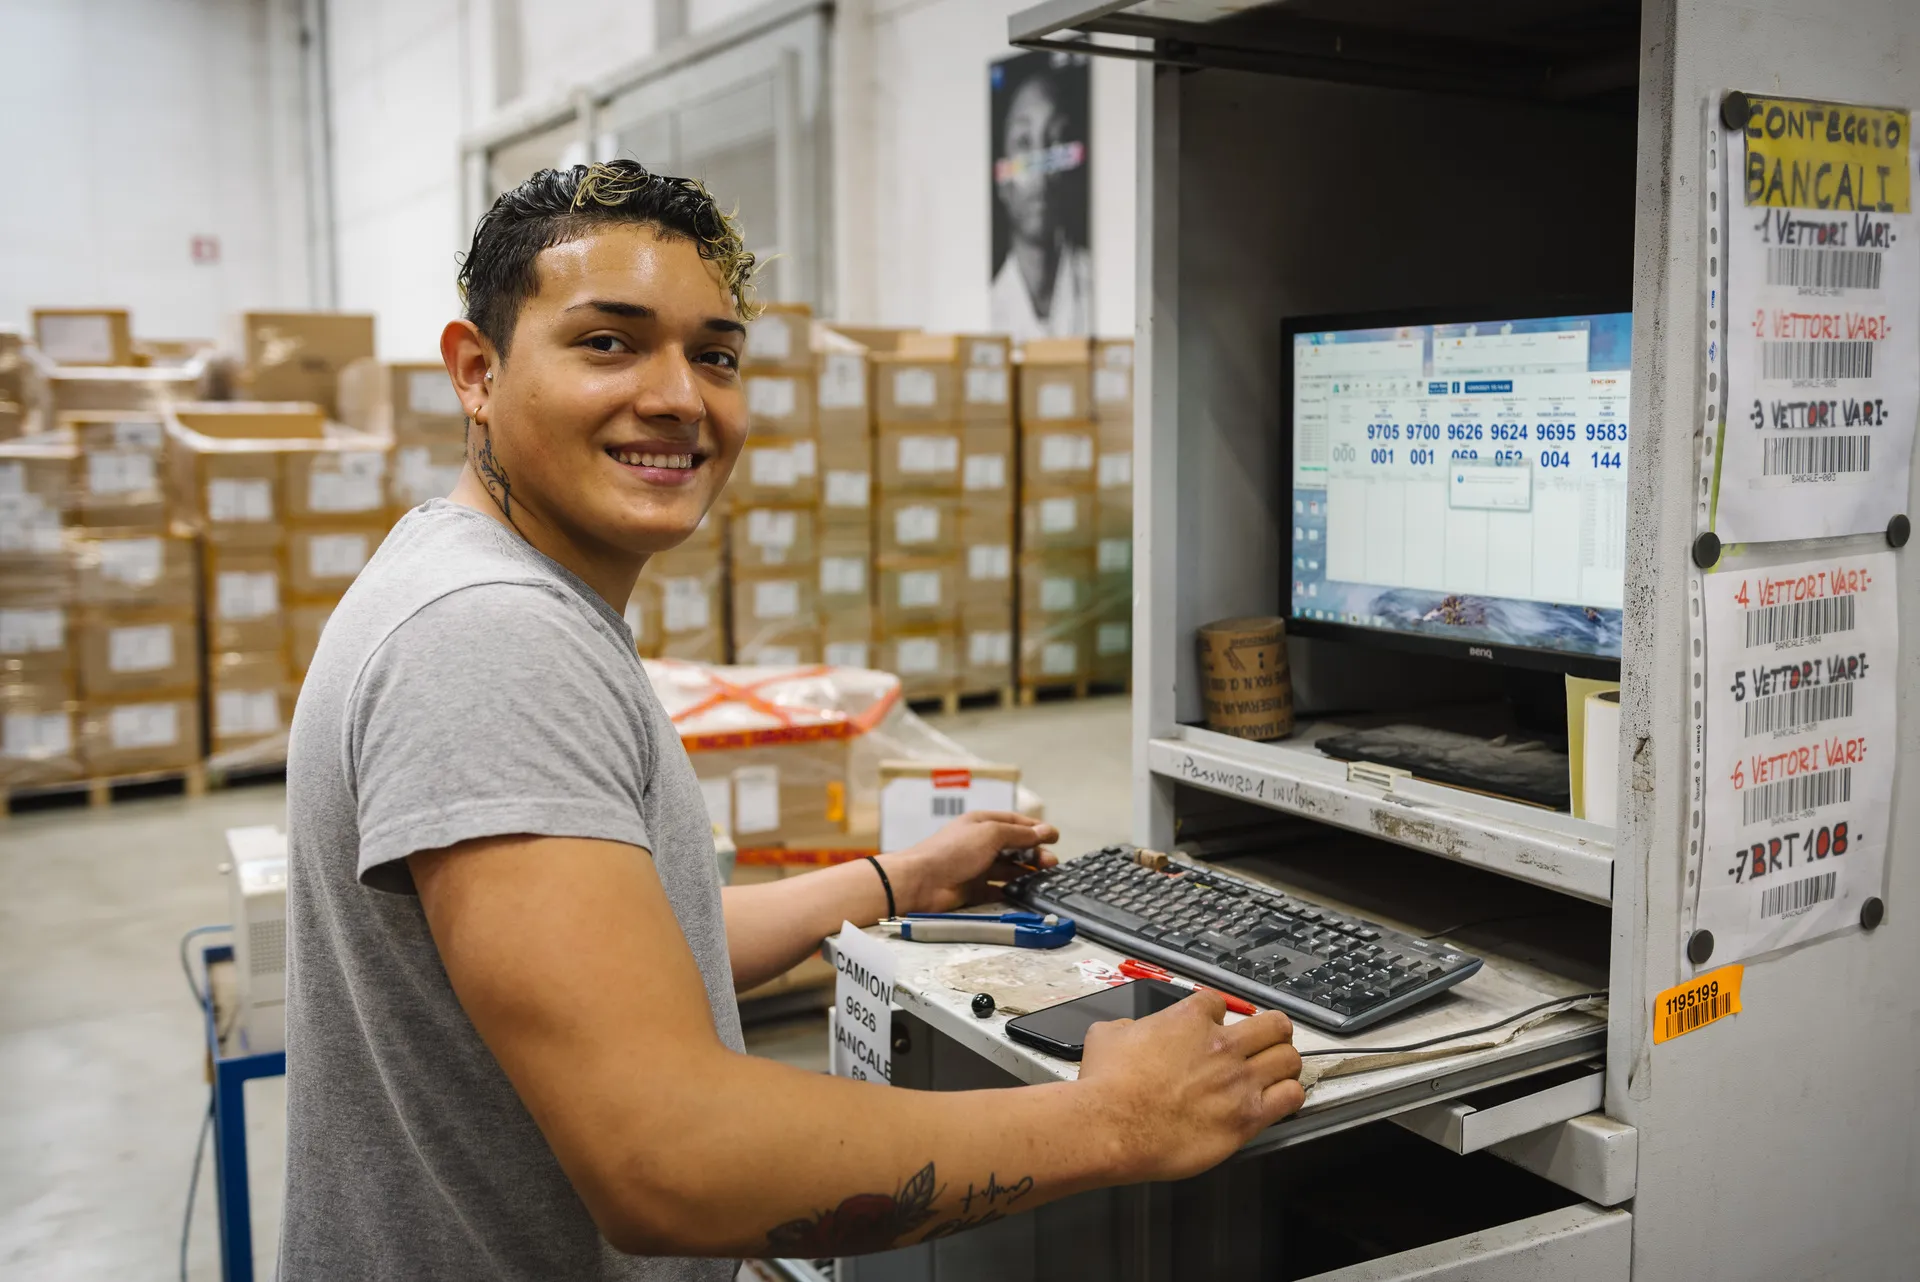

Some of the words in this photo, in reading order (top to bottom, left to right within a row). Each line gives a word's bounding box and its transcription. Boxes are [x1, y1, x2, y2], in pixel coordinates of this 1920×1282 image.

[1746, 104, 1900, 148] CONTEGGIO
[1747, 152, 1894, 213] BANCALI
[1776, 209, 1847, 247] VETTORI
[1773, 309, 1841, 340] VETTORI
[1367, 424, 1400, 440] 9705
[1406, 424, 1440, 440] 9700
[1447, 424, 1483, 440] 9626
[1490, 424, 1528, 440] 9624
[1536, 424, 1576, 440] 9695
[1586, 424, 1628, 441] 9583
[1771, 399, 1837, 429] VETTORI
[1371, 449, 1394, 464] 001
[1410, 449, 1434, 465] 001
[1541, 451, 1570, 467] 004
[1591, 452, 1621, 468] 144
[1758, 572, 1826, 607] VETTORI
[1752, 659, 1822, 698] VETTORI
[1752, 744, 1819, 785] VETTORI
[1803, 820, 1849, 863] 108
[836, 951, 891, 1006] CAMION
[846, 996, 877, 1032] 9626
[1666, 981, 1719, 1015] 1195199
